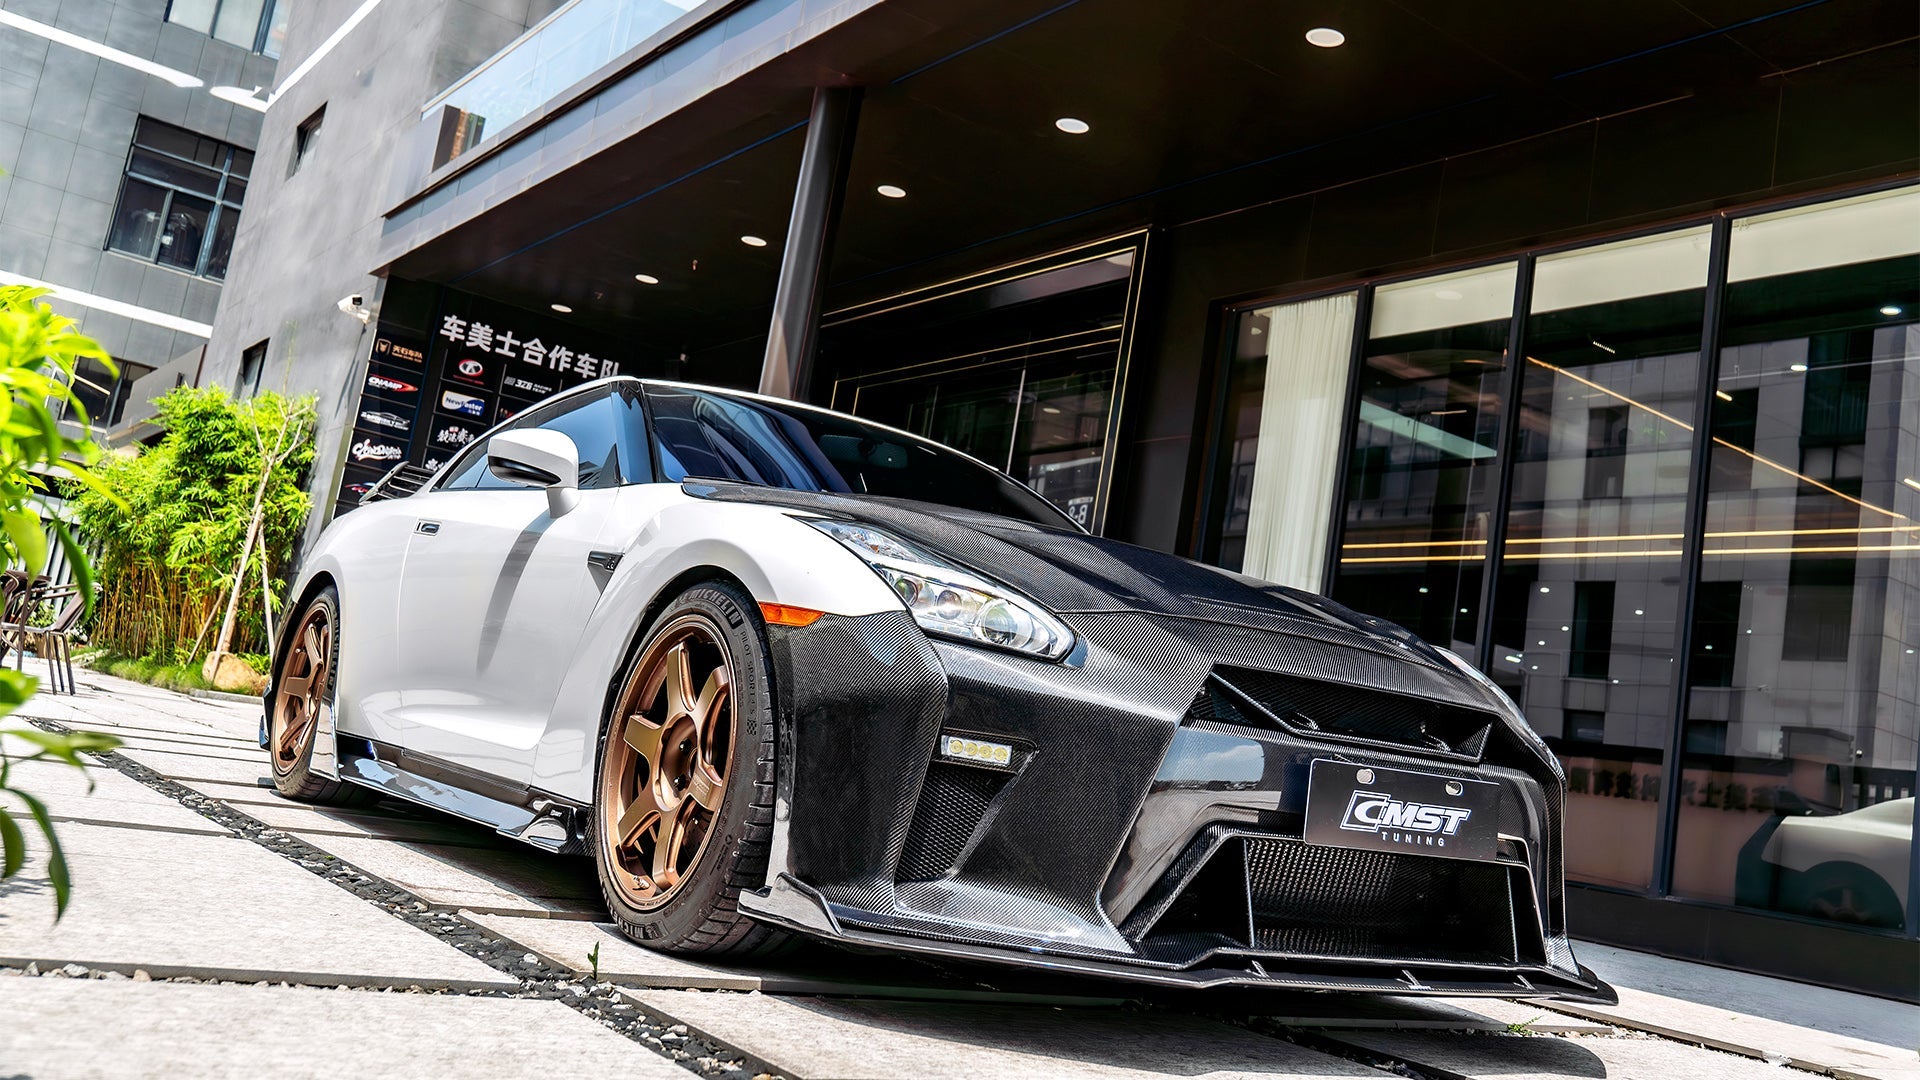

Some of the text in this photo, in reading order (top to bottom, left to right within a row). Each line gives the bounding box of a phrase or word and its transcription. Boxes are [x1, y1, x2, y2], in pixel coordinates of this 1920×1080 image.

[440, 315, 620, 379] 车美士合作车队
[688, 588, 741, 625] MICHELIN
[328, 619, 340, 686] MICHELIN
[747, 661, 756, 696] SPORT
[1350, 797, 1471, 835] CMST
[1381, 831, 1445, 847] TUNING
